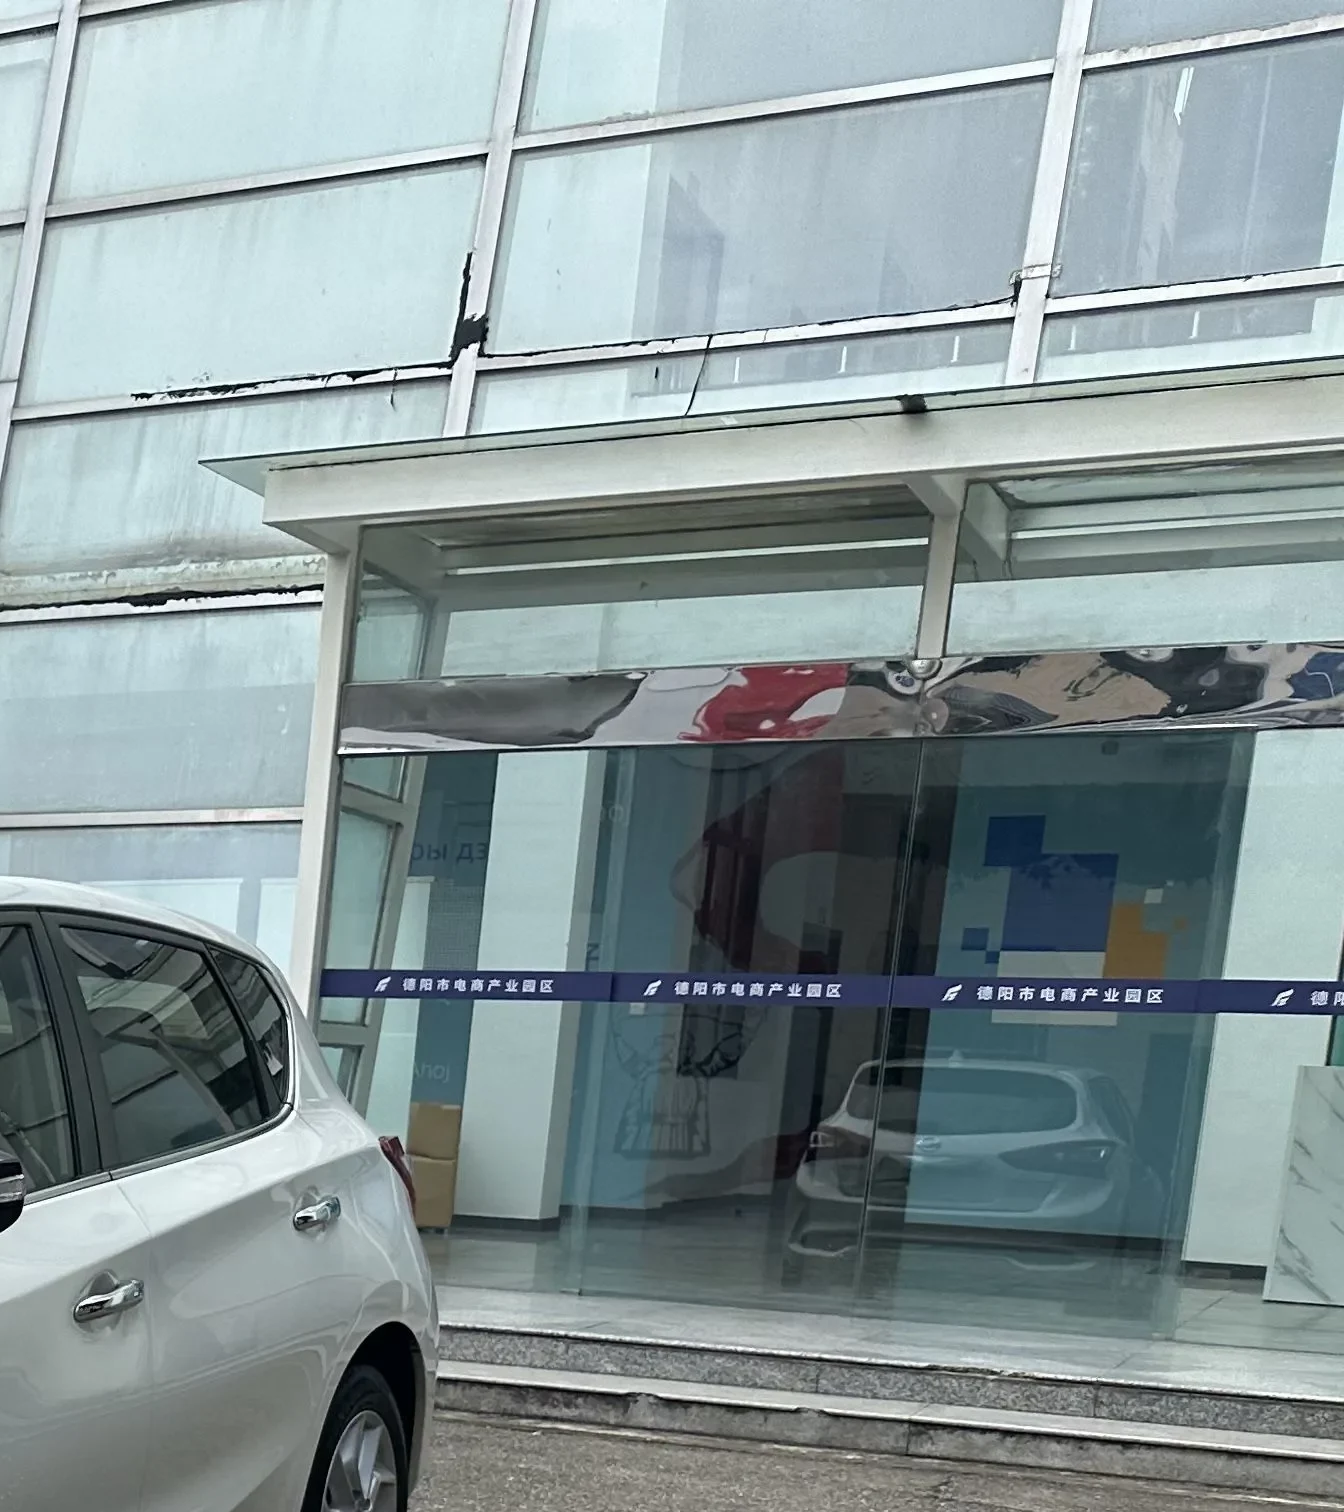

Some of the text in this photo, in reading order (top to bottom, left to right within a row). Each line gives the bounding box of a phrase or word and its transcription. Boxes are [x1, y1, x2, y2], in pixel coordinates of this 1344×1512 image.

[402, 978, 554, 993] 德阳市电商产业园区
[674, 981, 842, 998] 德阳市电商产业园区
[976, 985, 1164, 1004] 德阳市电商产业园区
